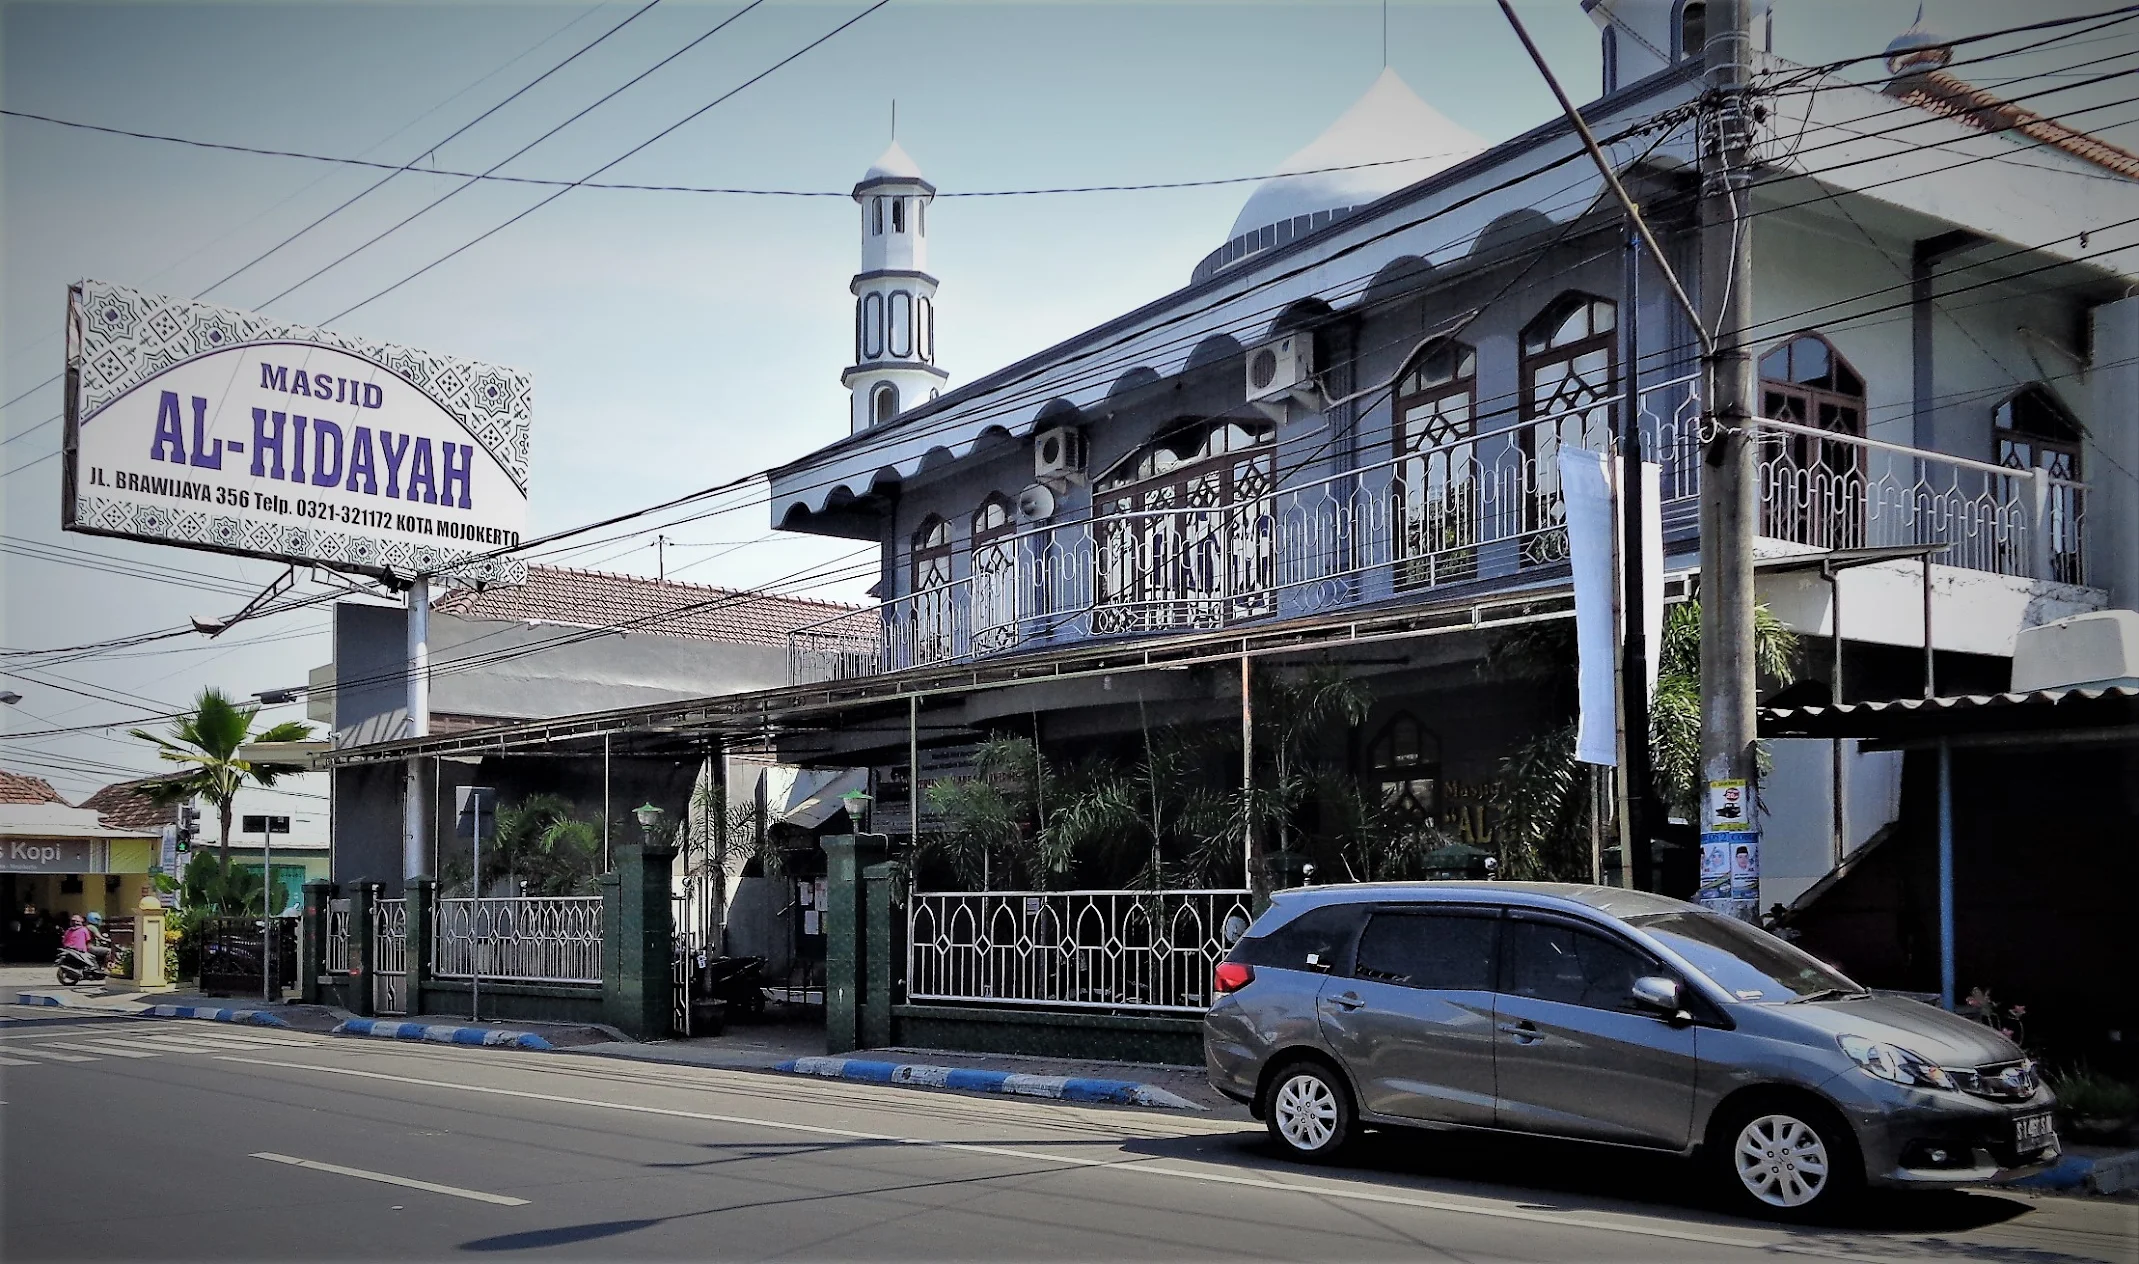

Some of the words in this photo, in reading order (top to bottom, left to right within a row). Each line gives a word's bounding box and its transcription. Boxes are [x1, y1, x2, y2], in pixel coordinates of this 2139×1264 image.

[259, 362, 383, 409] MASJID
[150, 390, 473, 510] AL-HIDAYAH
[89, 466, 111, 488] JL.
[115, 470, 211, 502] BRAWIJAYA
[215, 486, 249, 508] 356
[254, 491, 293, 515] Telp.
[296, 499, 393, 530] 0321-321172
[397, 513, 433, 536] KOTA
[436, 519, 520, 548] MOJOKERTO
[11, 841, 61, 865] Kopi
